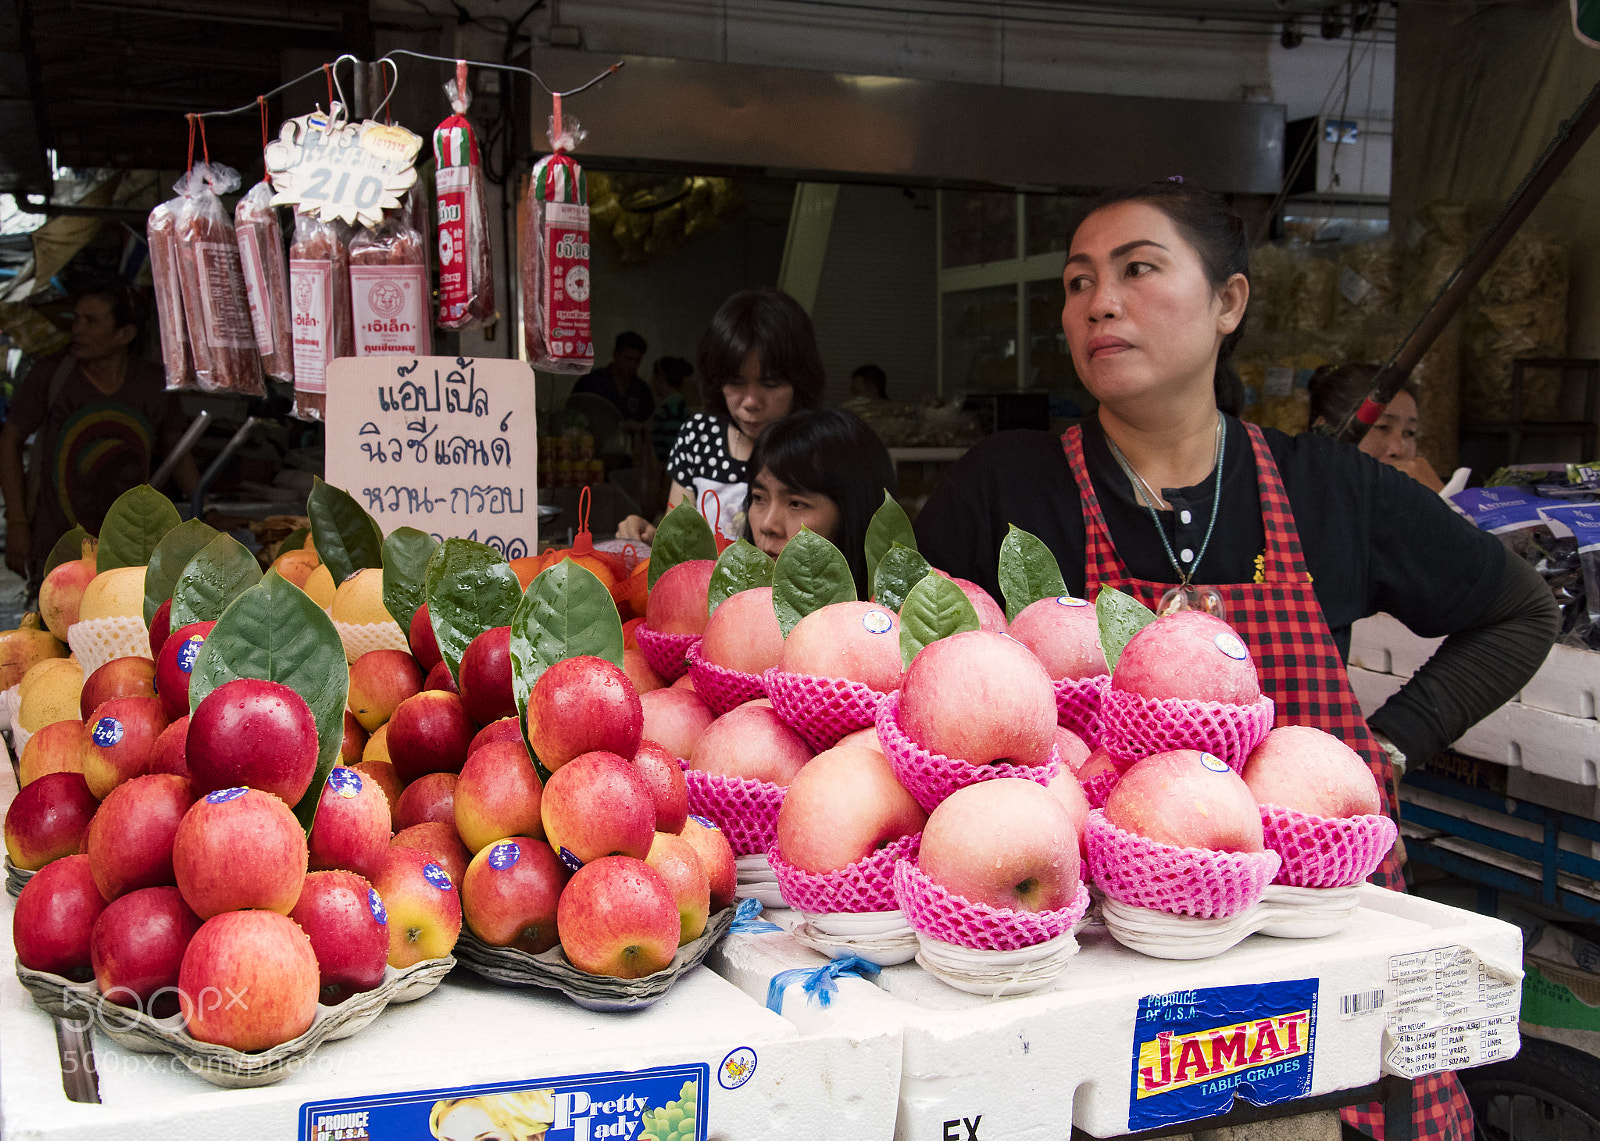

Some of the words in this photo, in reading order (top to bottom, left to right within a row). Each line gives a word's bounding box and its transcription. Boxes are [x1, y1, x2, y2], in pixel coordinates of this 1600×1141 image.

[301, 168, 382, 208] 210
[96, 726, 116, 744] JAZZ
[494, 846, 508, 867] JAZZ
[1147, 991, 1198, 1008] PRODUCE
[1146, 1008, 1160, 1022] OF
[1164, 1005, 1200, 1021] U.S.A.
[1404, 1034, 1416, 1042] lbs.
[1449, 1036, 1464, 1044] PLAIN
[1488, 1038, 1502, 1048] LINER
[1140, 1012, 1309, 1092] JAMAT
[1449, 1046, 1468, 1056] WRAPS
[1200, 1076, 1242, 1096] TABLE
[1246, 1059, 1301, 1082] GRAPES
[551, 1092, 649, 1130] Pretty
[318, 1112, 369, 1132] PRODUCE
[572, 1115, 639, 1141] Lady
[318, 1131, 332, 1141] OF
[334, 1128, 368, 1140] U.S.A.
